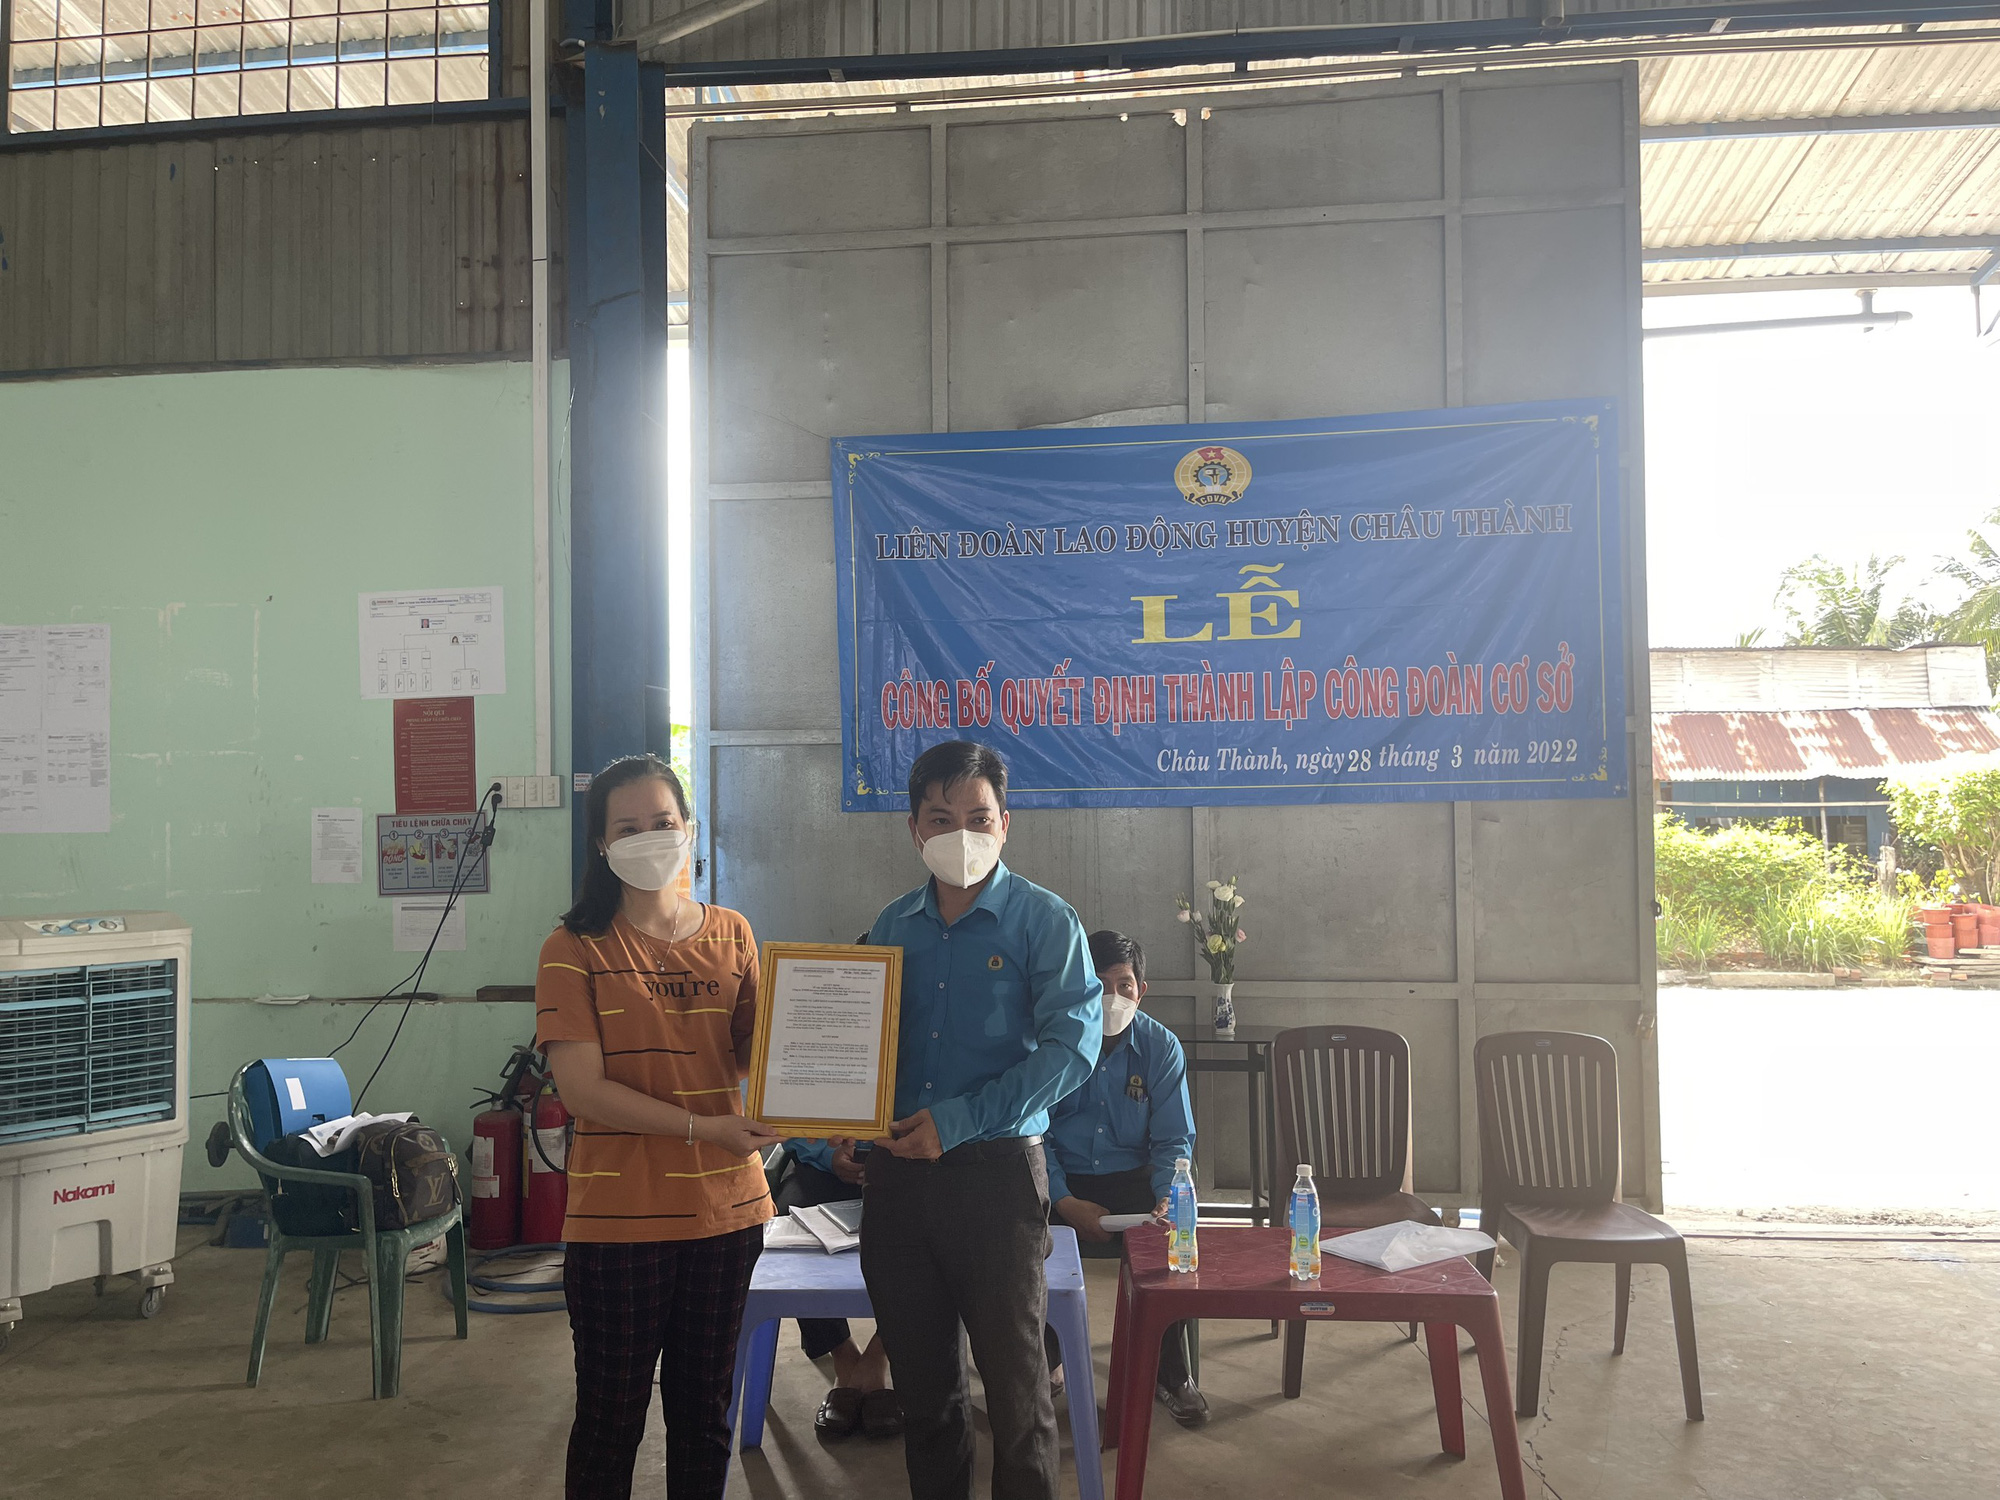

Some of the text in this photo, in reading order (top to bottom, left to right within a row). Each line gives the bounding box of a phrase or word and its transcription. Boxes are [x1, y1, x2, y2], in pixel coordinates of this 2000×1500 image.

[875, 499, 1572, 560] LIÊN ĐOÀN LAO ĐỘNG HUYỆN CHÂU THÀNH
[1131, 563, 1301, 643] LỄ
[881, 641, 1575, 736] CÔNG BỐ QUYẾT ĐỊNH THÀNH LẬP CÔNG ĐOÀN CƠ SỞ
[1156, 738, 1578, 775] Châu Thành, ngày 28 tháng 3 năm 2022
[410, 818, 429, 829] LỆNH
[431, 818, 450, 827] CHỮA
[642, 974, 719, 1001] you're
[53, 1180, 115, 1205] Nakami
